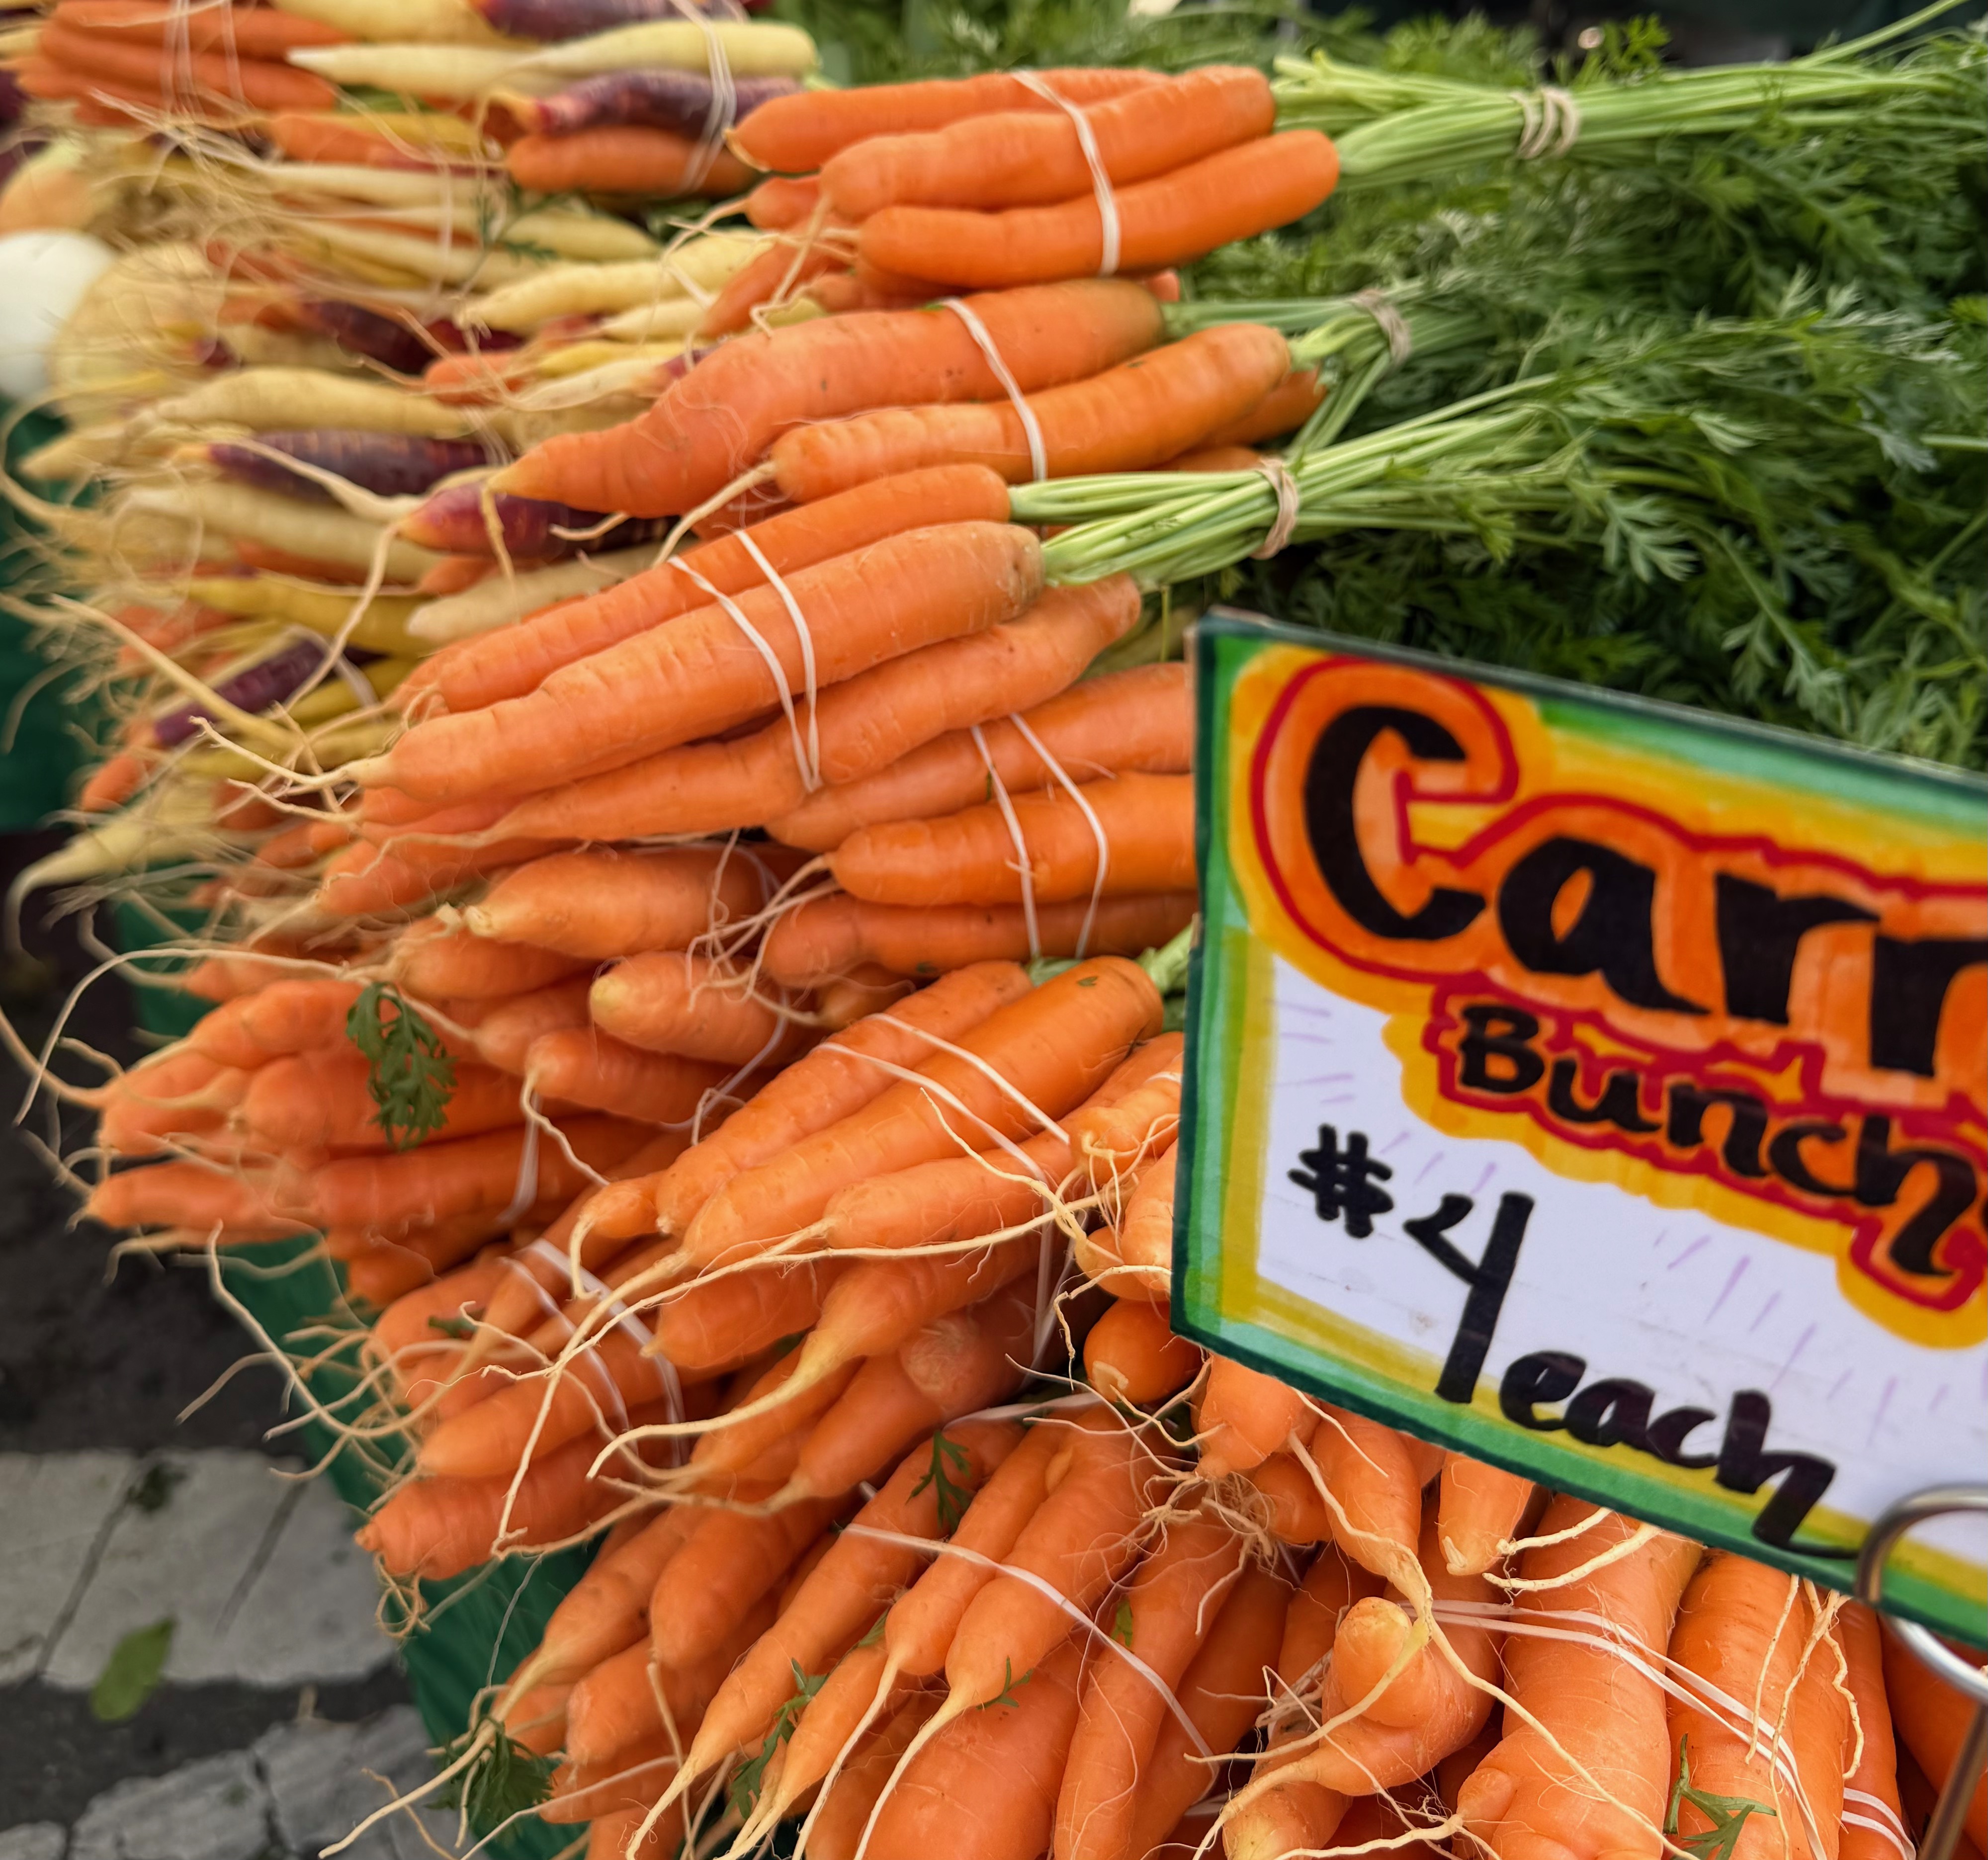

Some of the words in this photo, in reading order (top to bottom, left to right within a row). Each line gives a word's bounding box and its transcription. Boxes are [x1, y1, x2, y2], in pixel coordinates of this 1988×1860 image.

[1303, 706, 1988, 1078] Carr
[1460, 1003, 1988, 1276] Bunch
[1499, 1351, 1859, 1559] each
